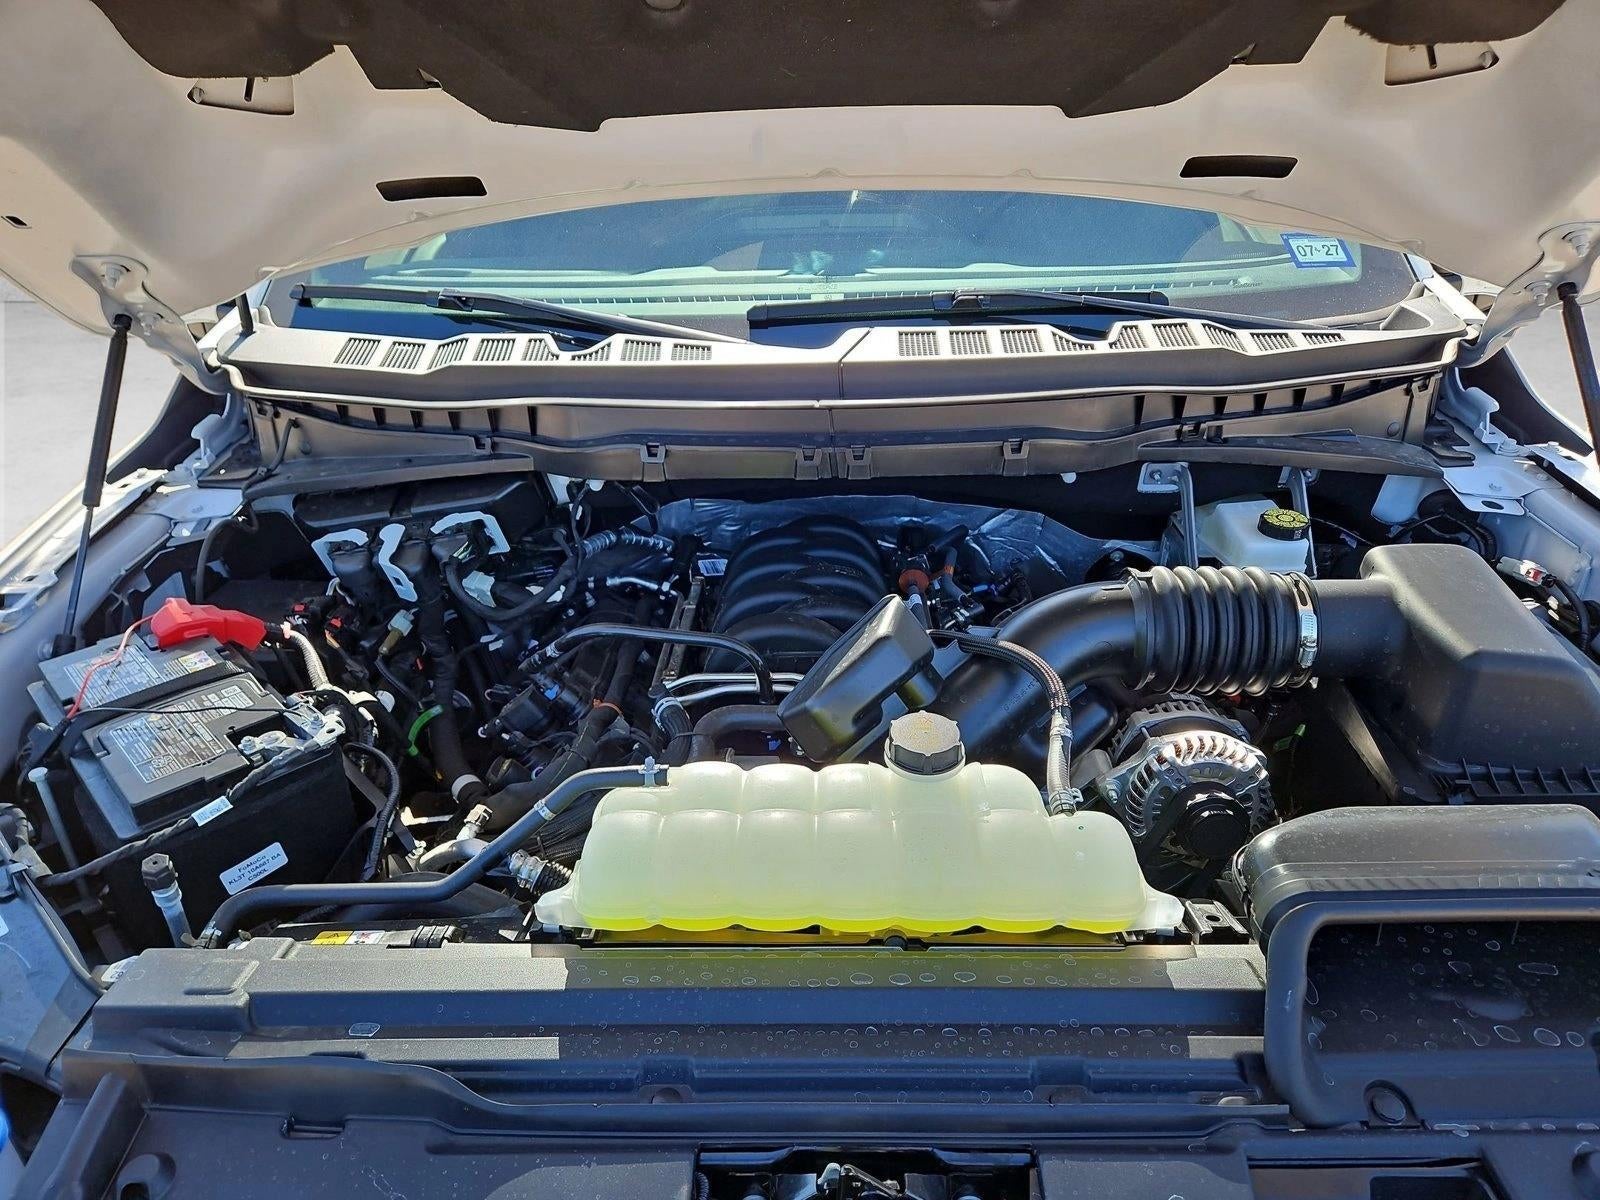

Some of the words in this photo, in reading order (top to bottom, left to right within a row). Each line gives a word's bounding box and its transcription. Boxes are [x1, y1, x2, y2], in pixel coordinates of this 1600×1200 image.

[1296, 244, 1313, 257] 07
[1321, 244, 1339, 256] 27
[237, 855, 267, 873] FoMoCo
